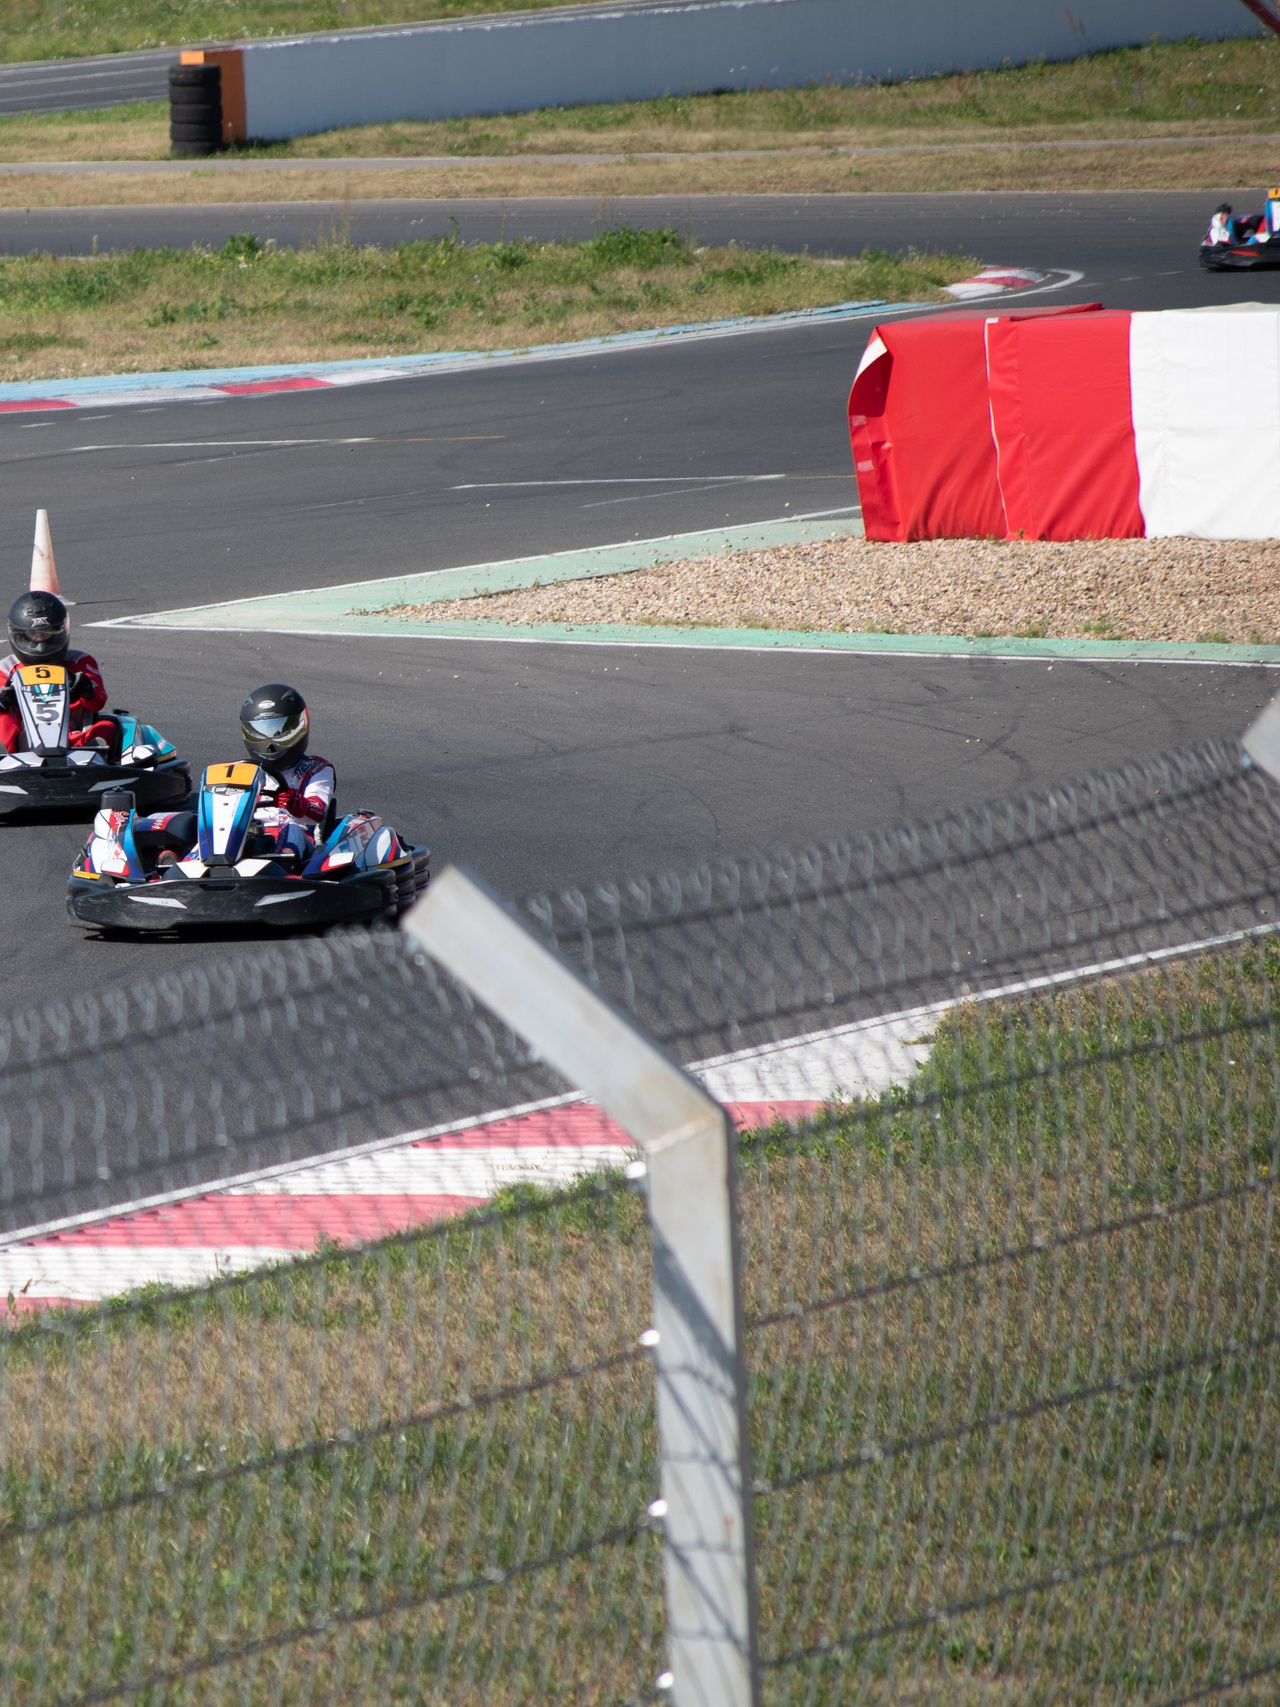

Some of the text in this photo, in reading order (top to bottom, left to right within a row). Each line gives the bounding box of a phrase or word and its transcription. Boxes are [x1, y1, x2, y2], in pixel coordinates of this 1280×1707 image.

[35, 666, 51, 679] 5
[35, 703, 60, 722] 5
[224, 764, 235, 778] 1
